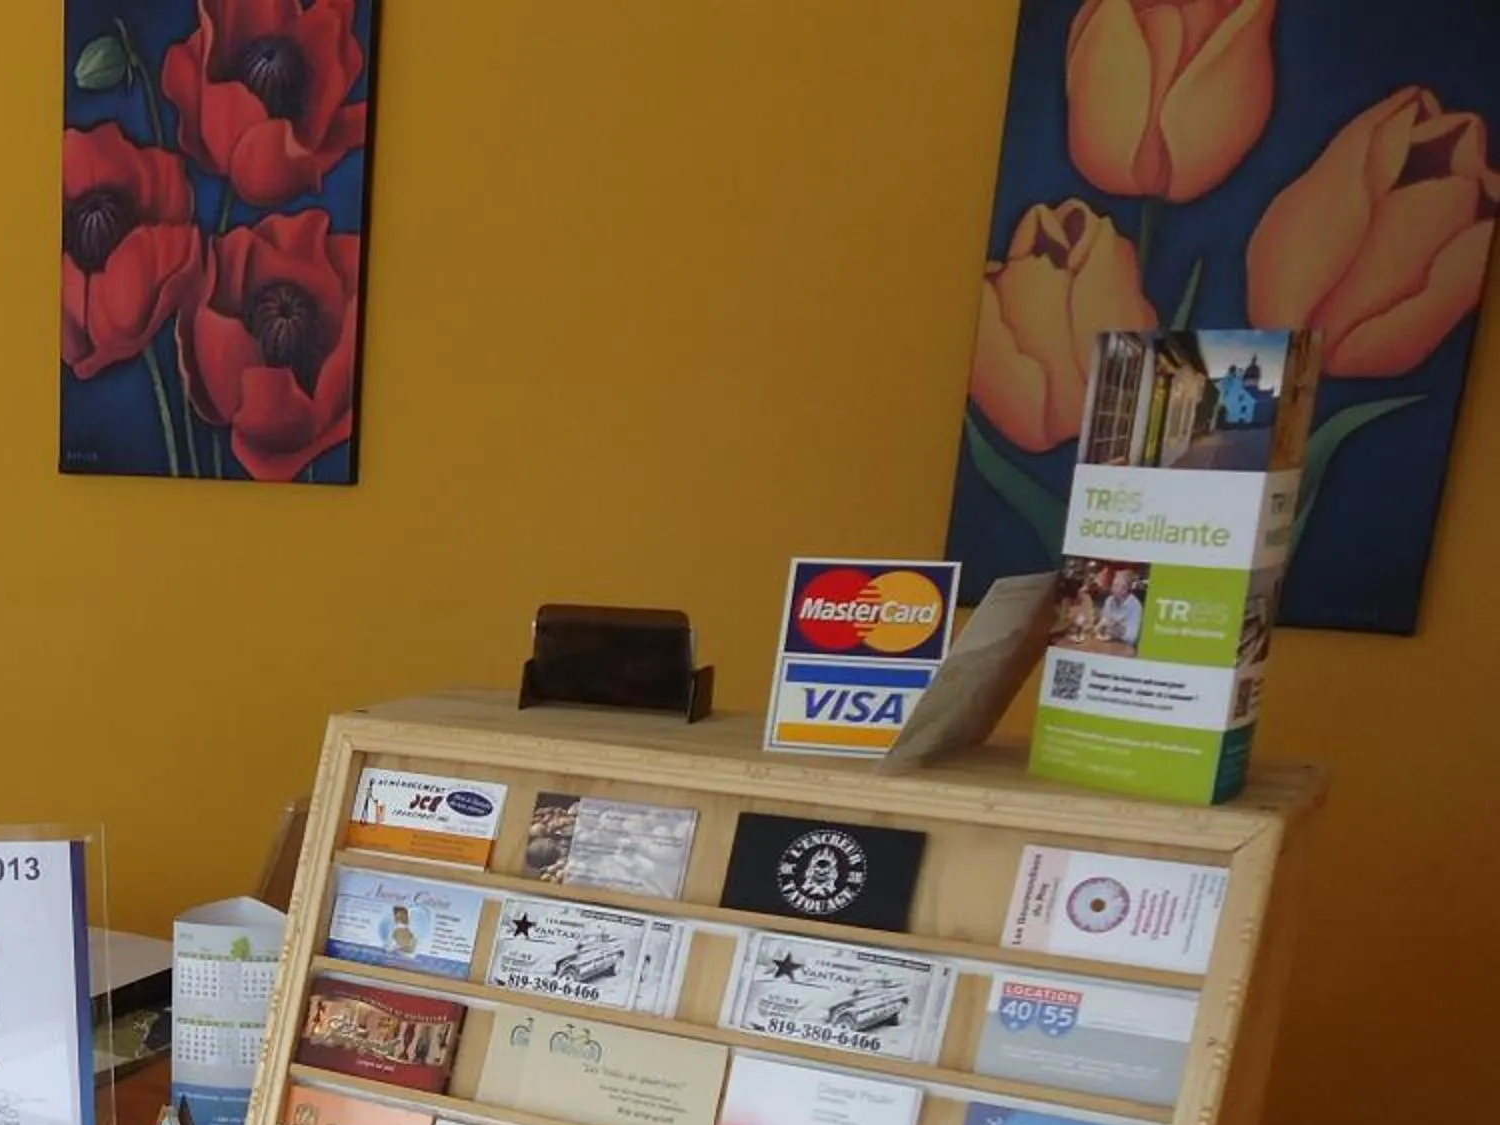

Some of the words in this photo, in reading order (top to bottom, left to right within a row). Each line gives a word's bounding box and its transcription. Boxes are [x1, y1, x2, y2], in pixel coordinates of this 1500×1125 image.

[1079, 513, 1231, 547] accueillante
[799, 598, 938, 624] MasterCard
[803, 687, 907, 723] VISA
[508, 973, 599, 1001] 819-380-6466
[1005, 983, 1079, 1003] LOCATION
[1002, 1000, 1032, 1021] 40
[1043, 1005, 1075, 1027] 55
[767, 1017, 881, 1051] 819-380-6466
